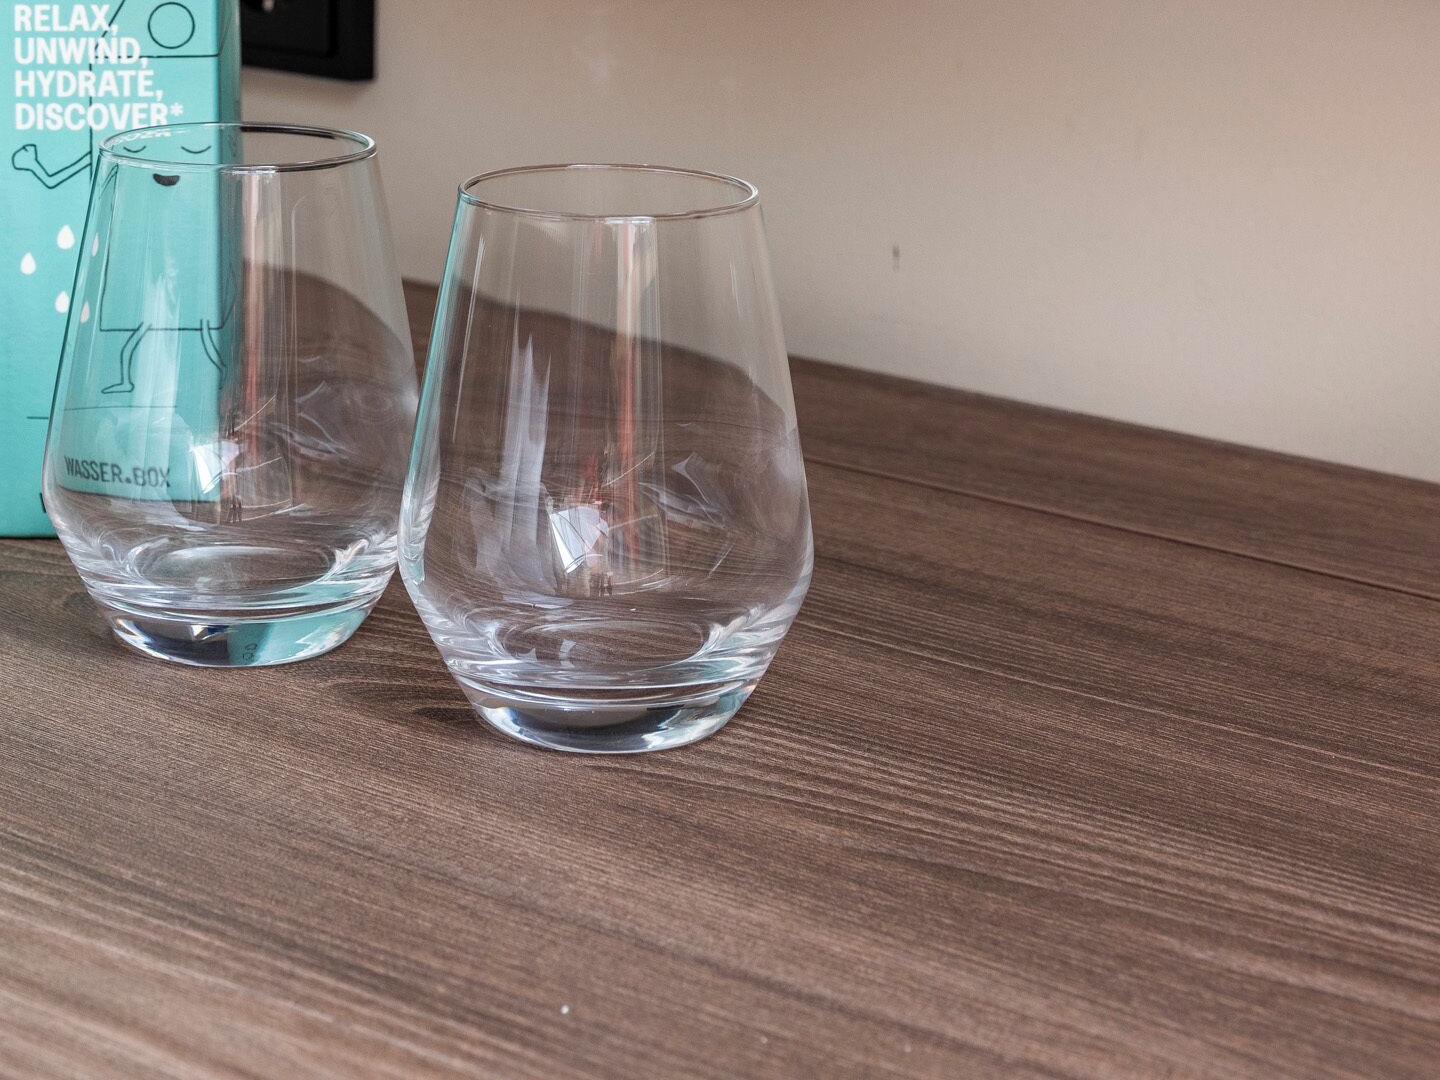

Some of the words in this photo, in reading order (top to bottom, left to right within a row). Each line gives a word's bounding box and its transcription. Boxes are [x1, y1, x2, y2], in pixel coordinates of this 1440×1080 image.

[14, 4, 118, 36] RELAX,
[14, 37, 149, 69] UNWIND,
[14, 70, 164, 102] HYDRATE,
